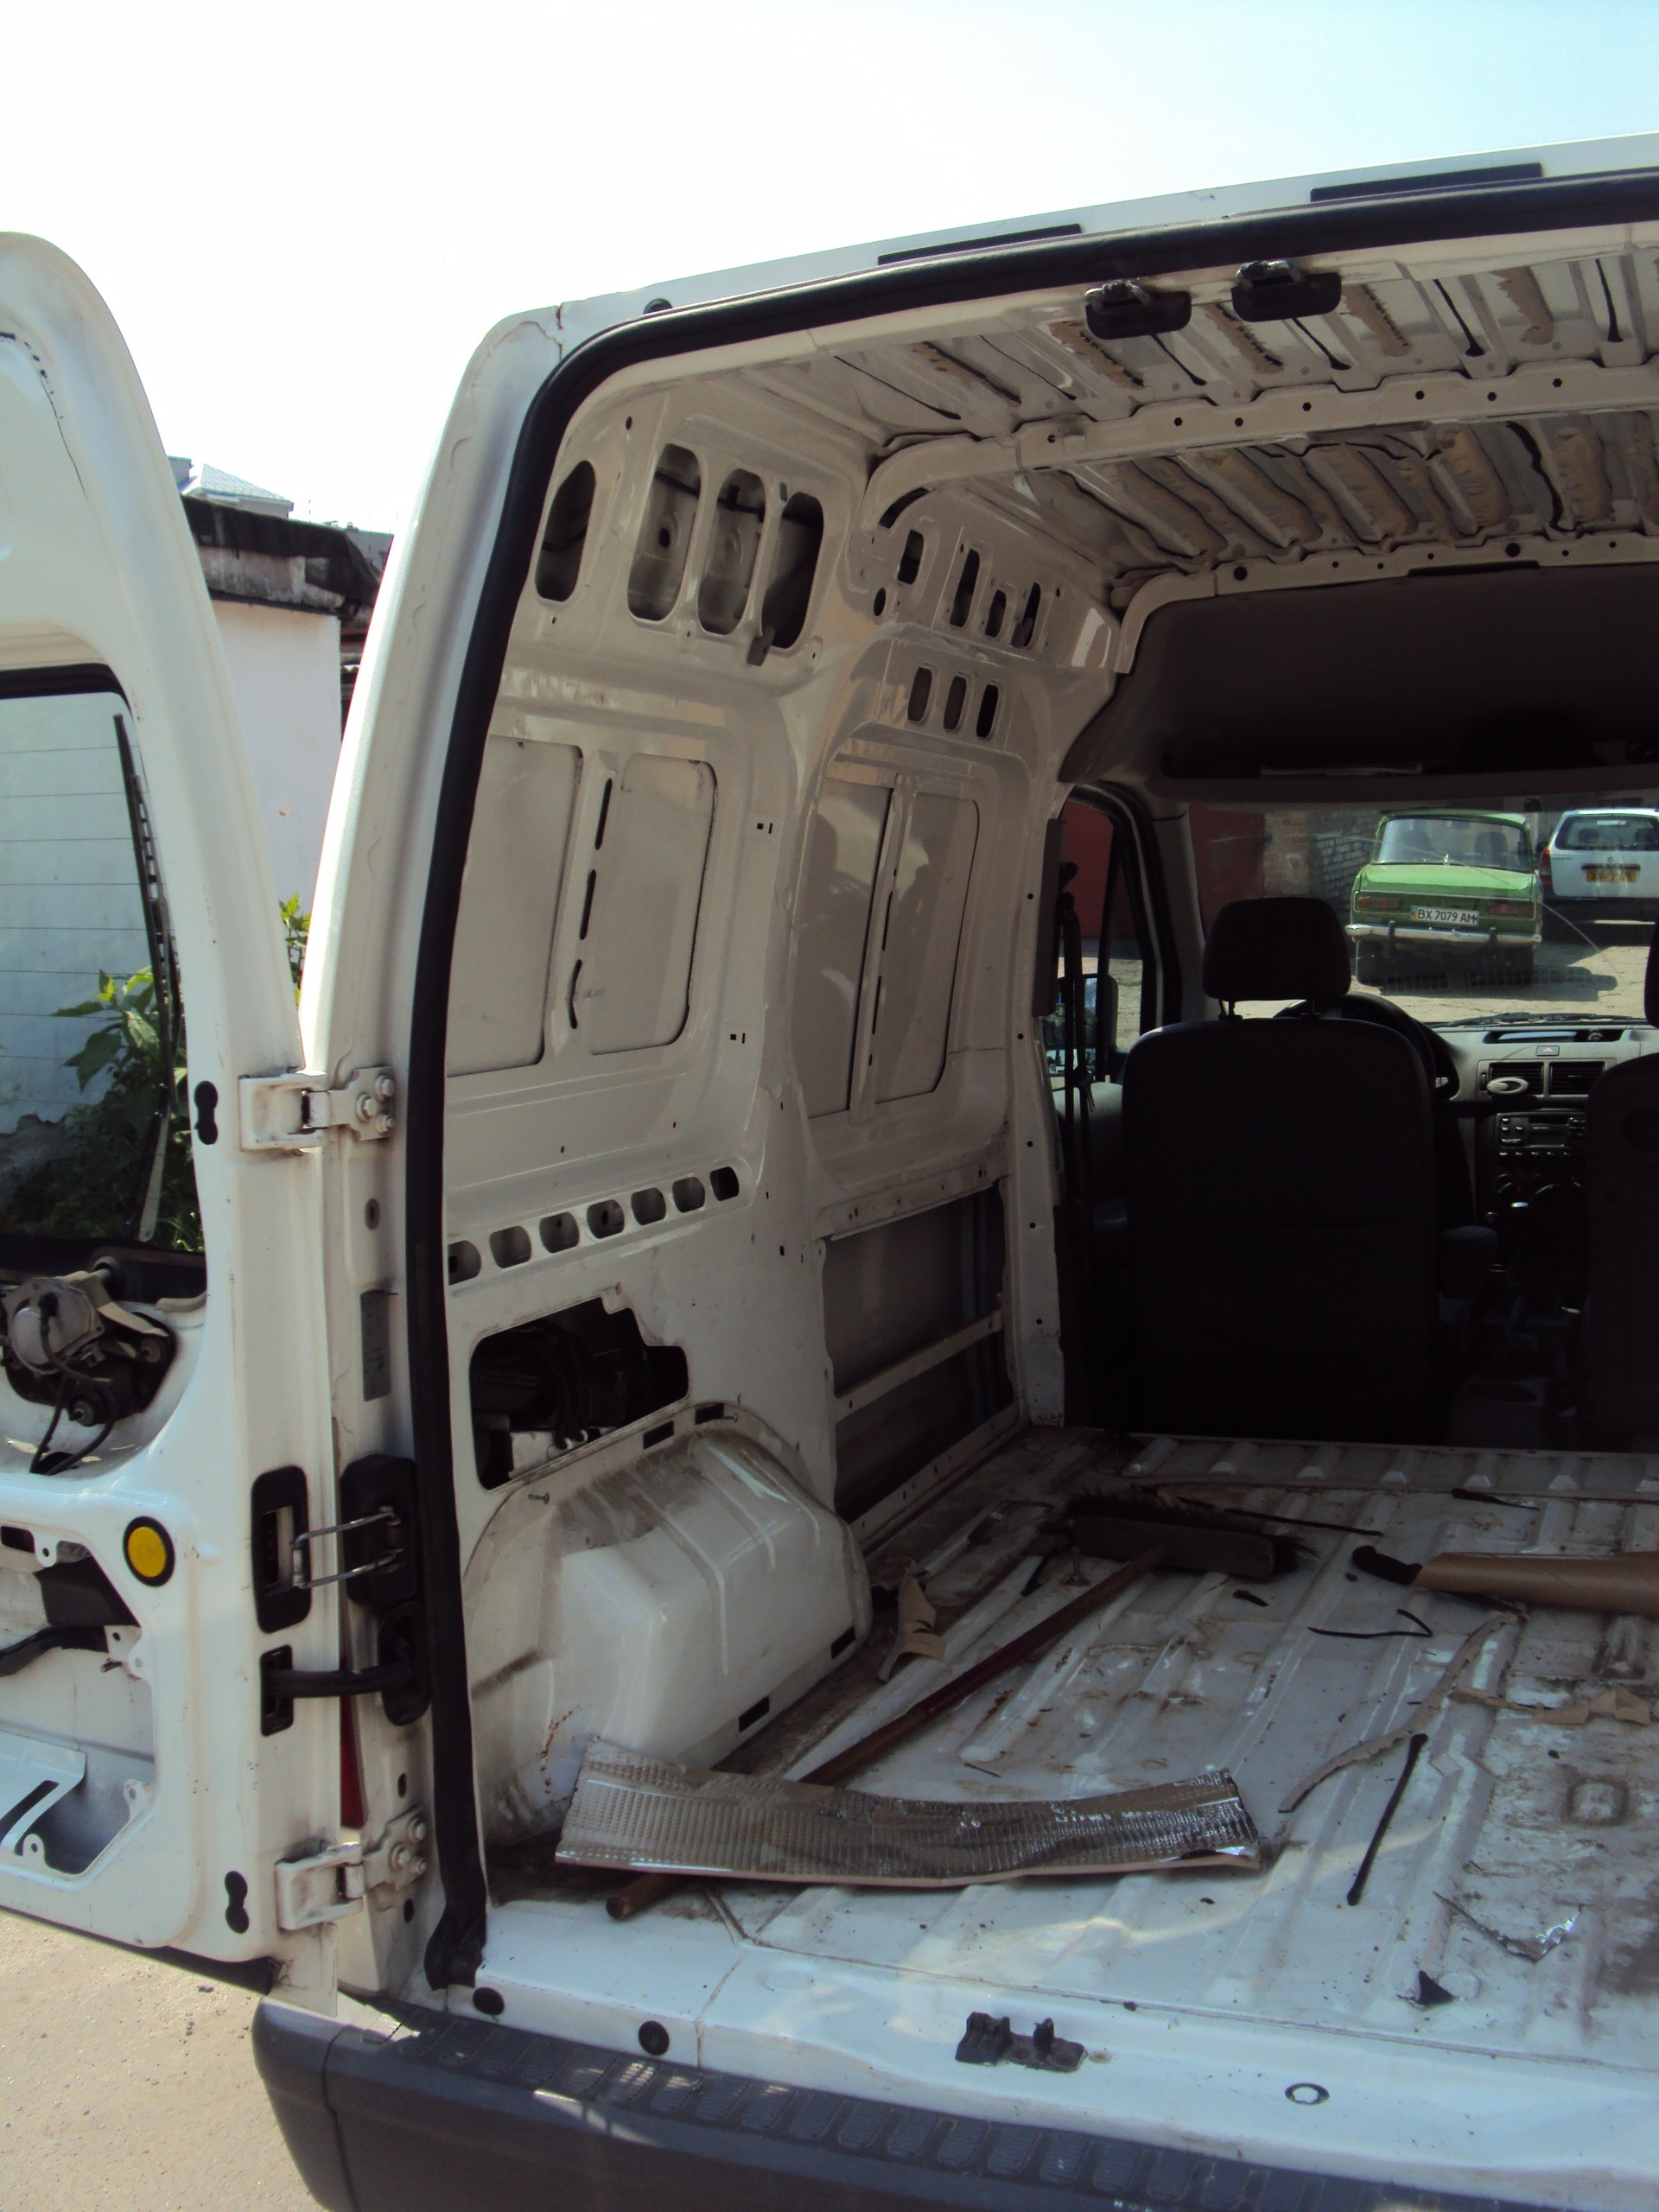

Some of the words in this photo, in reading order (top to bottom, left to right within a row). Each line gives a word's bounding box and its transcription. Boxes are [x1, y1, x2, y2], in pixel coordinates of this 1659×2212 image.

[1418, 909, 1433, 919] BX
[1435, 911, 1459, 922] 7079
[1460, 912, 1477, 924] AM
